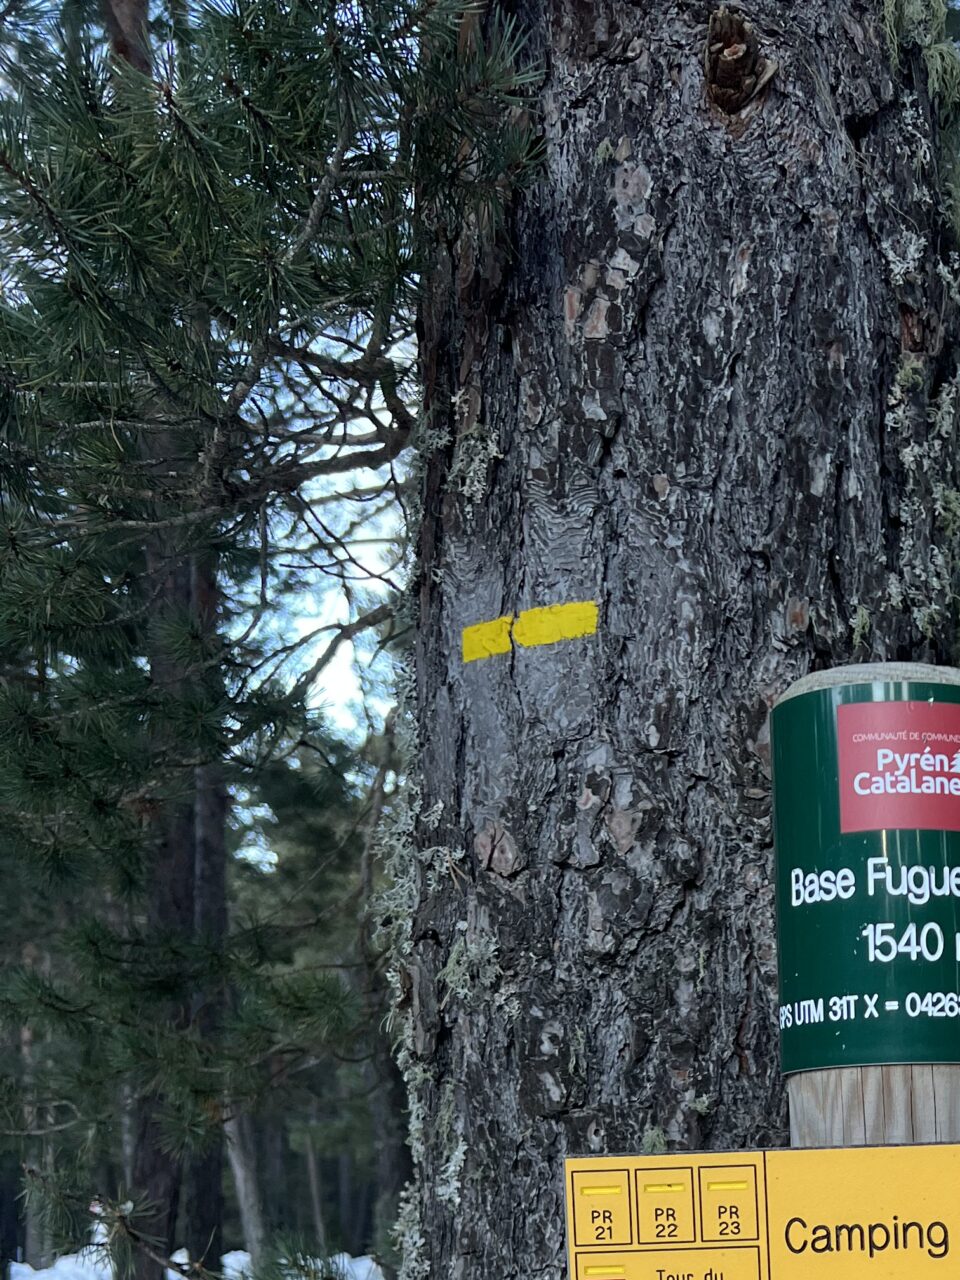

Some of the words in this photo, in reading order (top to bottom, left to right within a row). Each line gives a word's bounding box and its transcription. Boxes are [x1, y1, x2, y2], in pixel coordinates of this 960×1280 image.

[852, 730, 908, 743] COMMUNAUTÉ
[909, 731, 920, 741] DE
[791, 867, 856, 907] Base
[861, 922, 944, 963] 1540
[794, 998, 824, 1026] UTM
[828, 994, 859, 1021] 31T
[863, 993, 879, 1019] X
[885, 1001, 899, 1011] =
[591, 1210, 614, 1224] PR
[654, 1207, 677, 1222] PR
[717, 1205, 740, 1220] PR
[595, 1226, 614, 1240] 21
[655, 1224, 678, 1238] 22
[718, 1221, 741, 1236] 23
[784, 1215, 950, 1259] Camping
